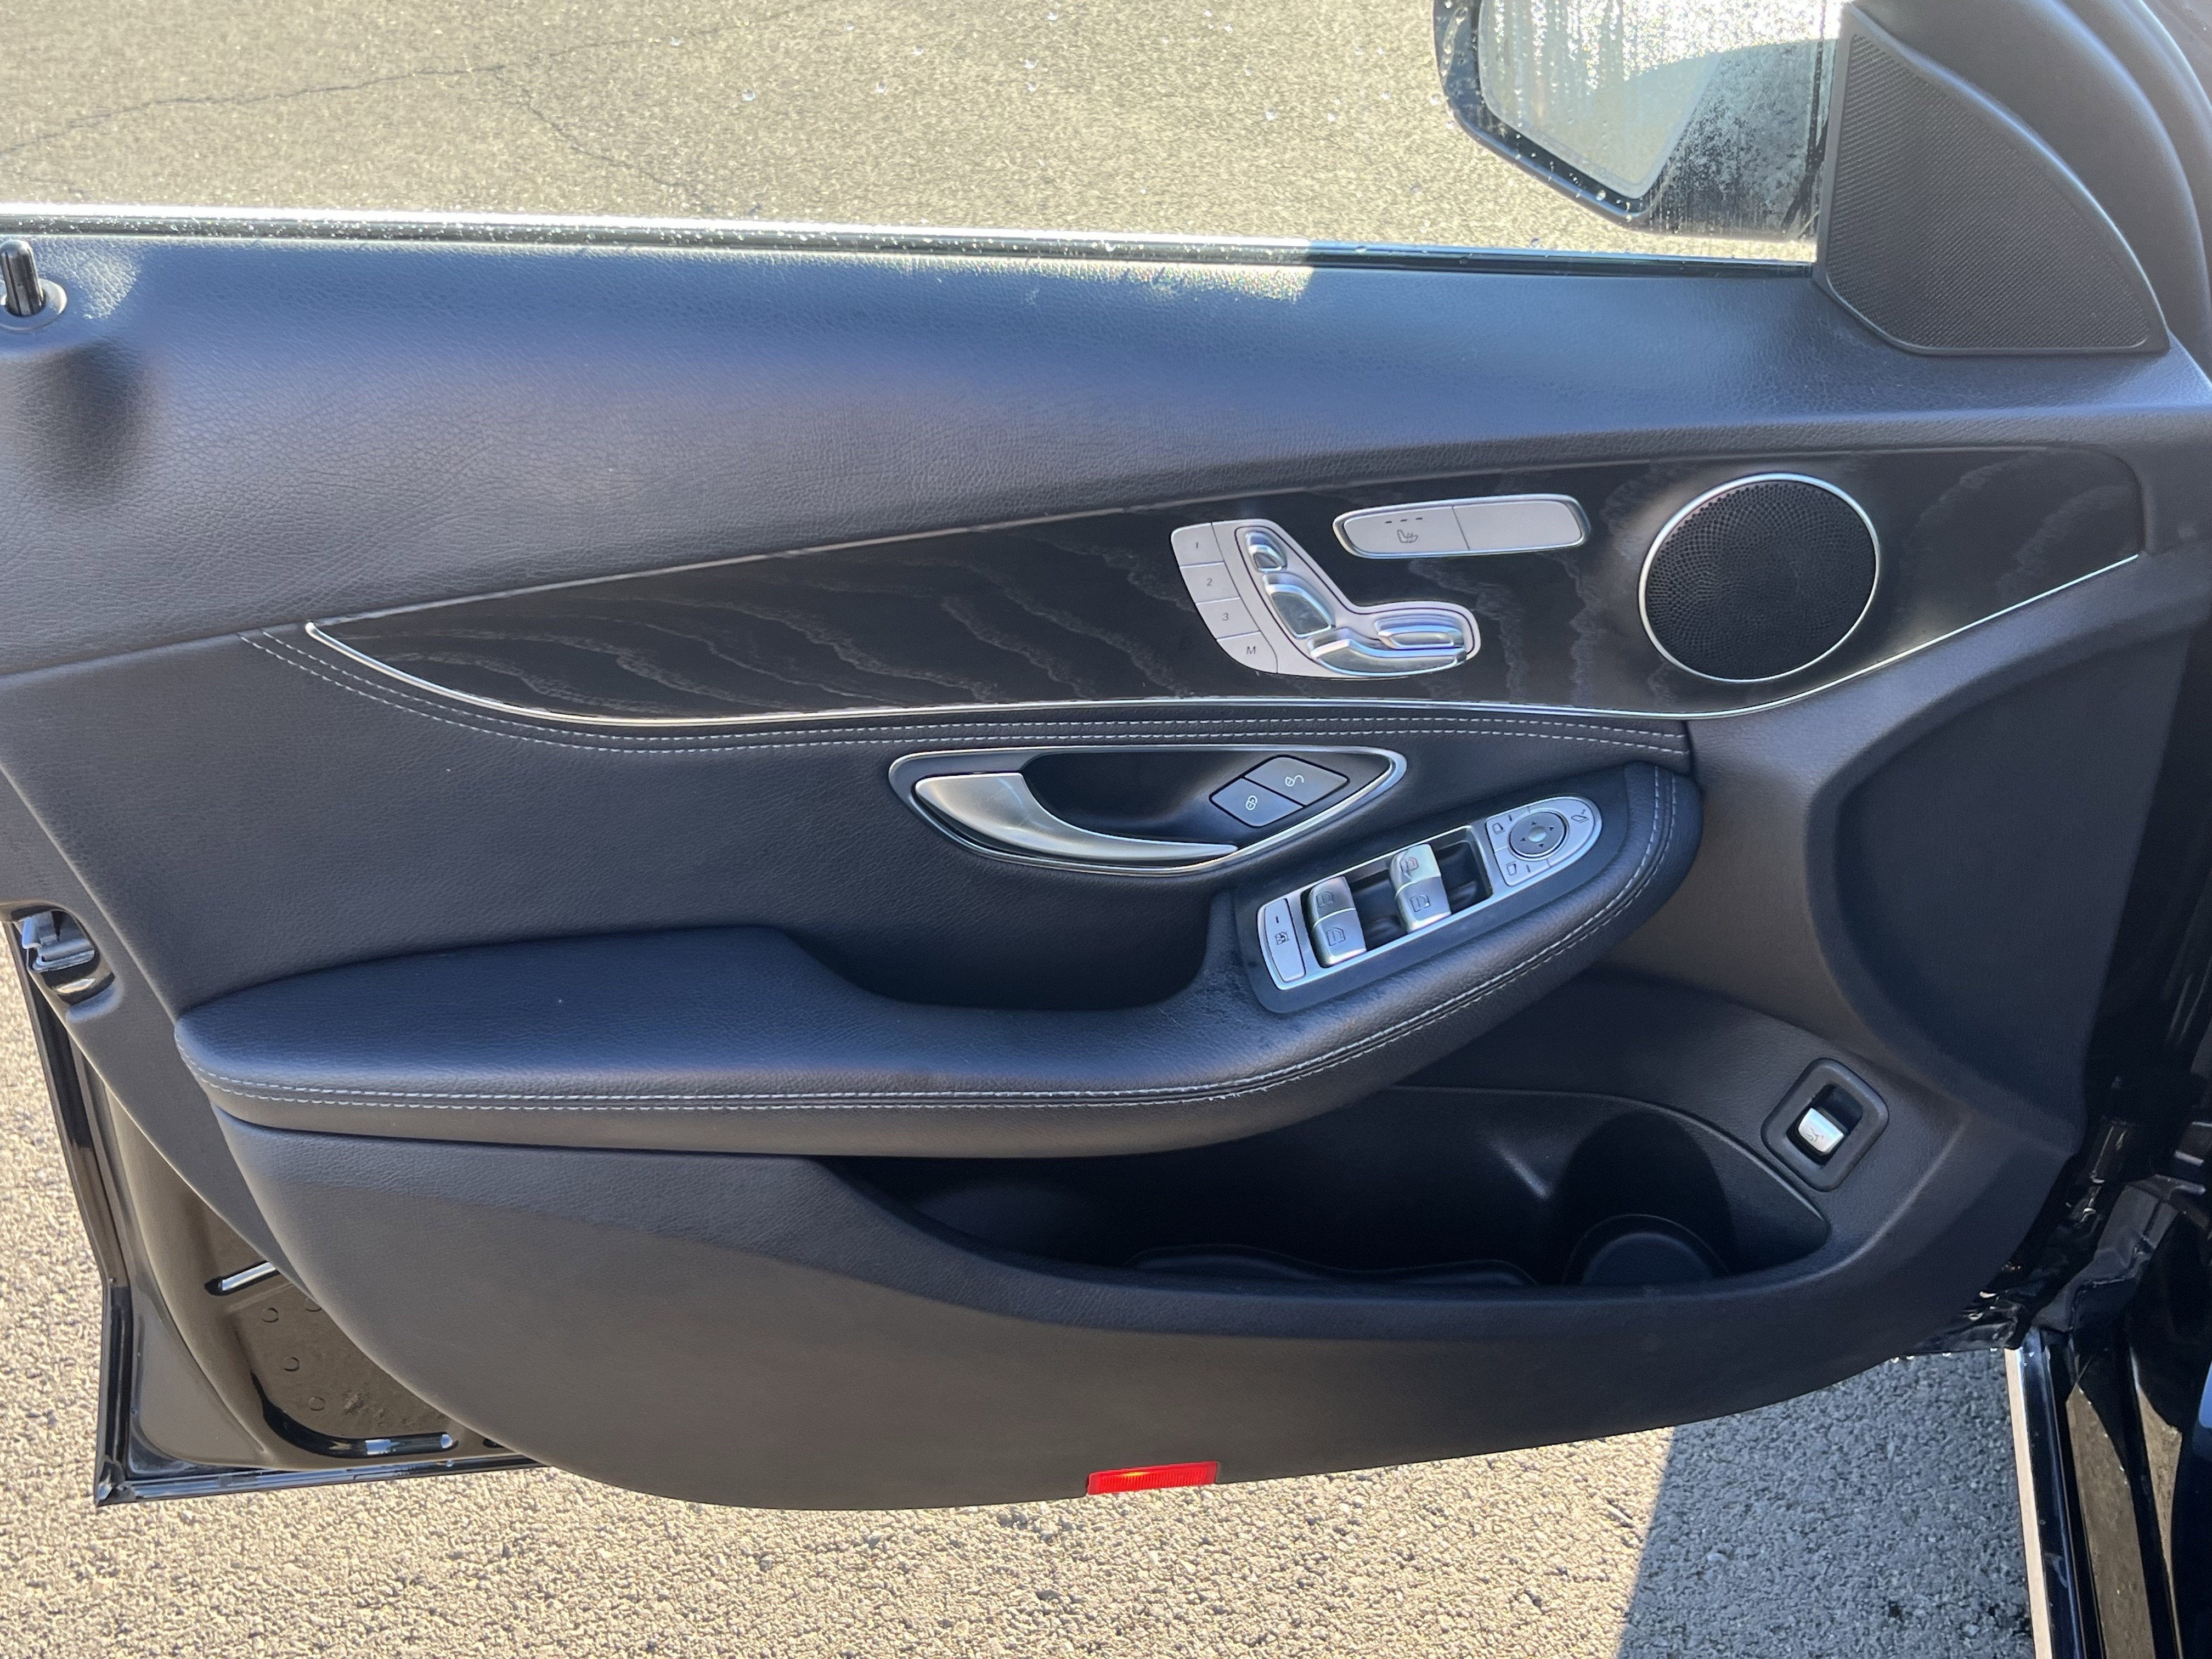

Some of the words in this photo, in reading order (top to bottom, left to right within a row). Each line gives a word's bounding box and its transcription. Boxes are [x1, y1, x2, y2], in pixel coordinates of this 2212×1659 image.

[1206, 578, 1212, 586] 2
[1222, 612, 1229, 621] 3
[1246, 646, 1256, 654] M
